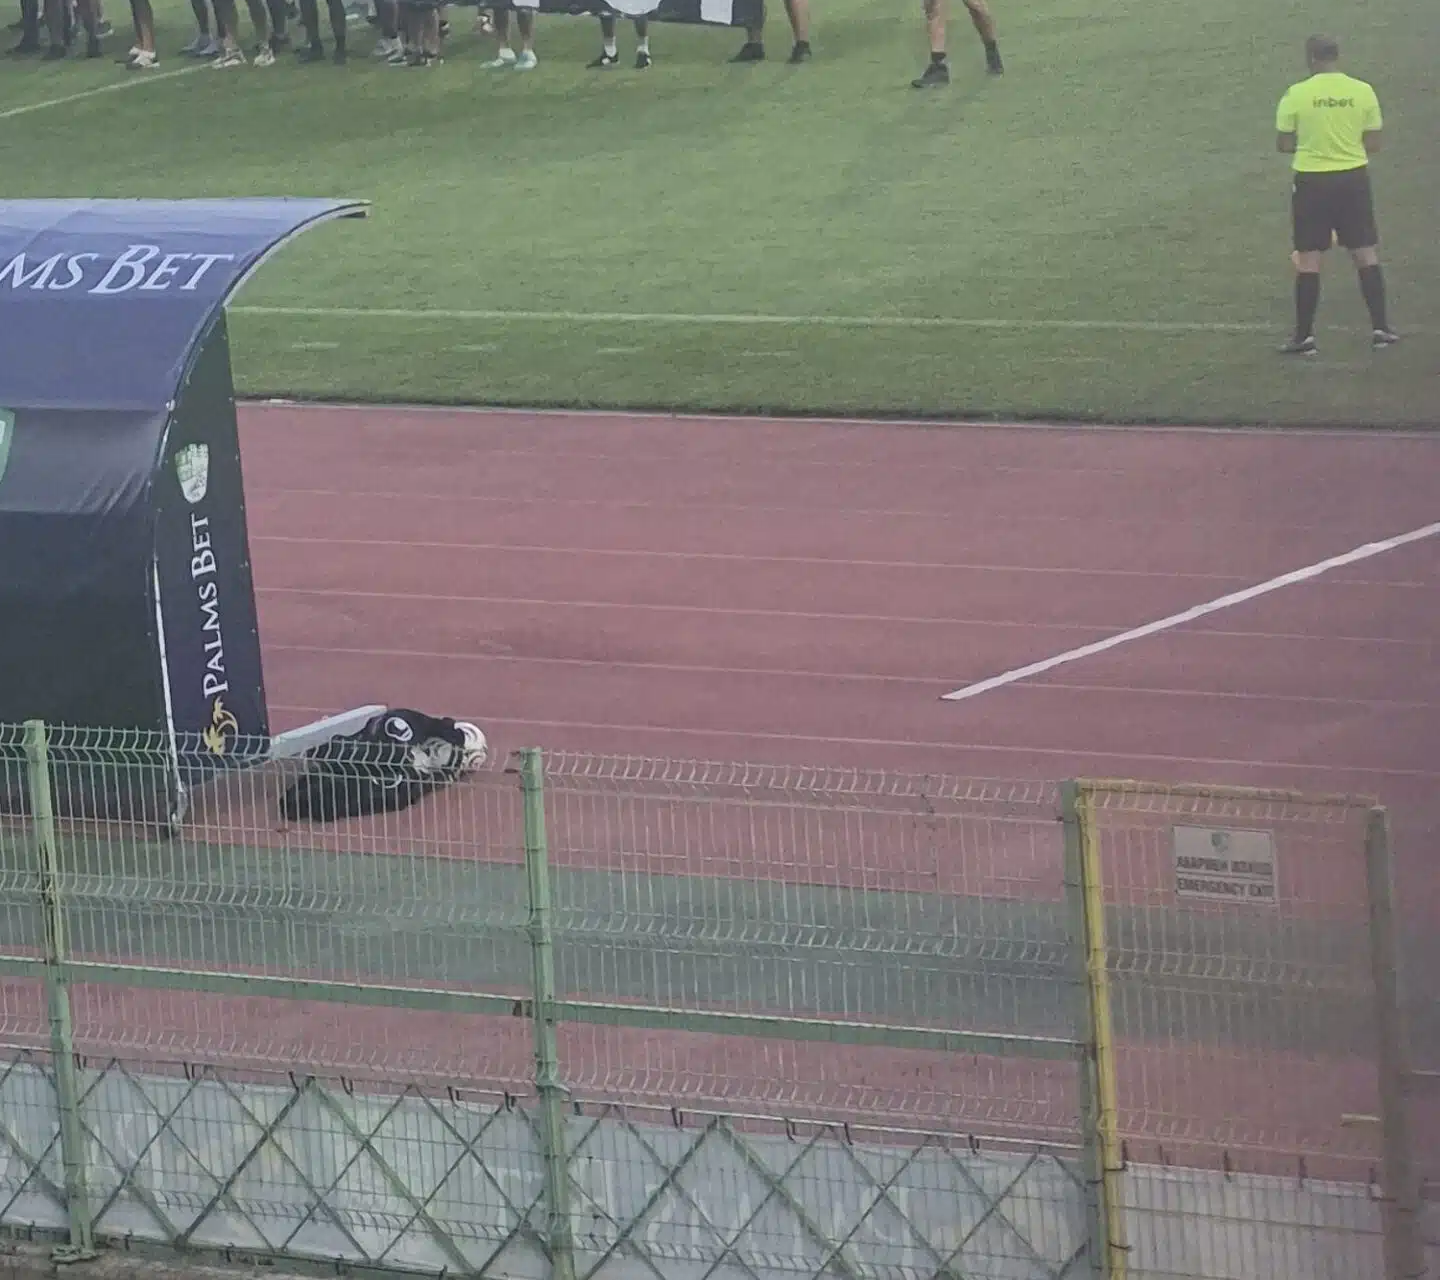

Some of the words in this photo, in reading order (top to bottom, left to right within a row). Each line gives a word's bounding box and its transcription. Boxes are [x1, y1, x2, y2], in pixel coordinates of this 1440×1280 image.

[87, 244, 235, 295] BET
[191, 513, 217, 580] BET
[198, 582, 229, 699] PALMS
